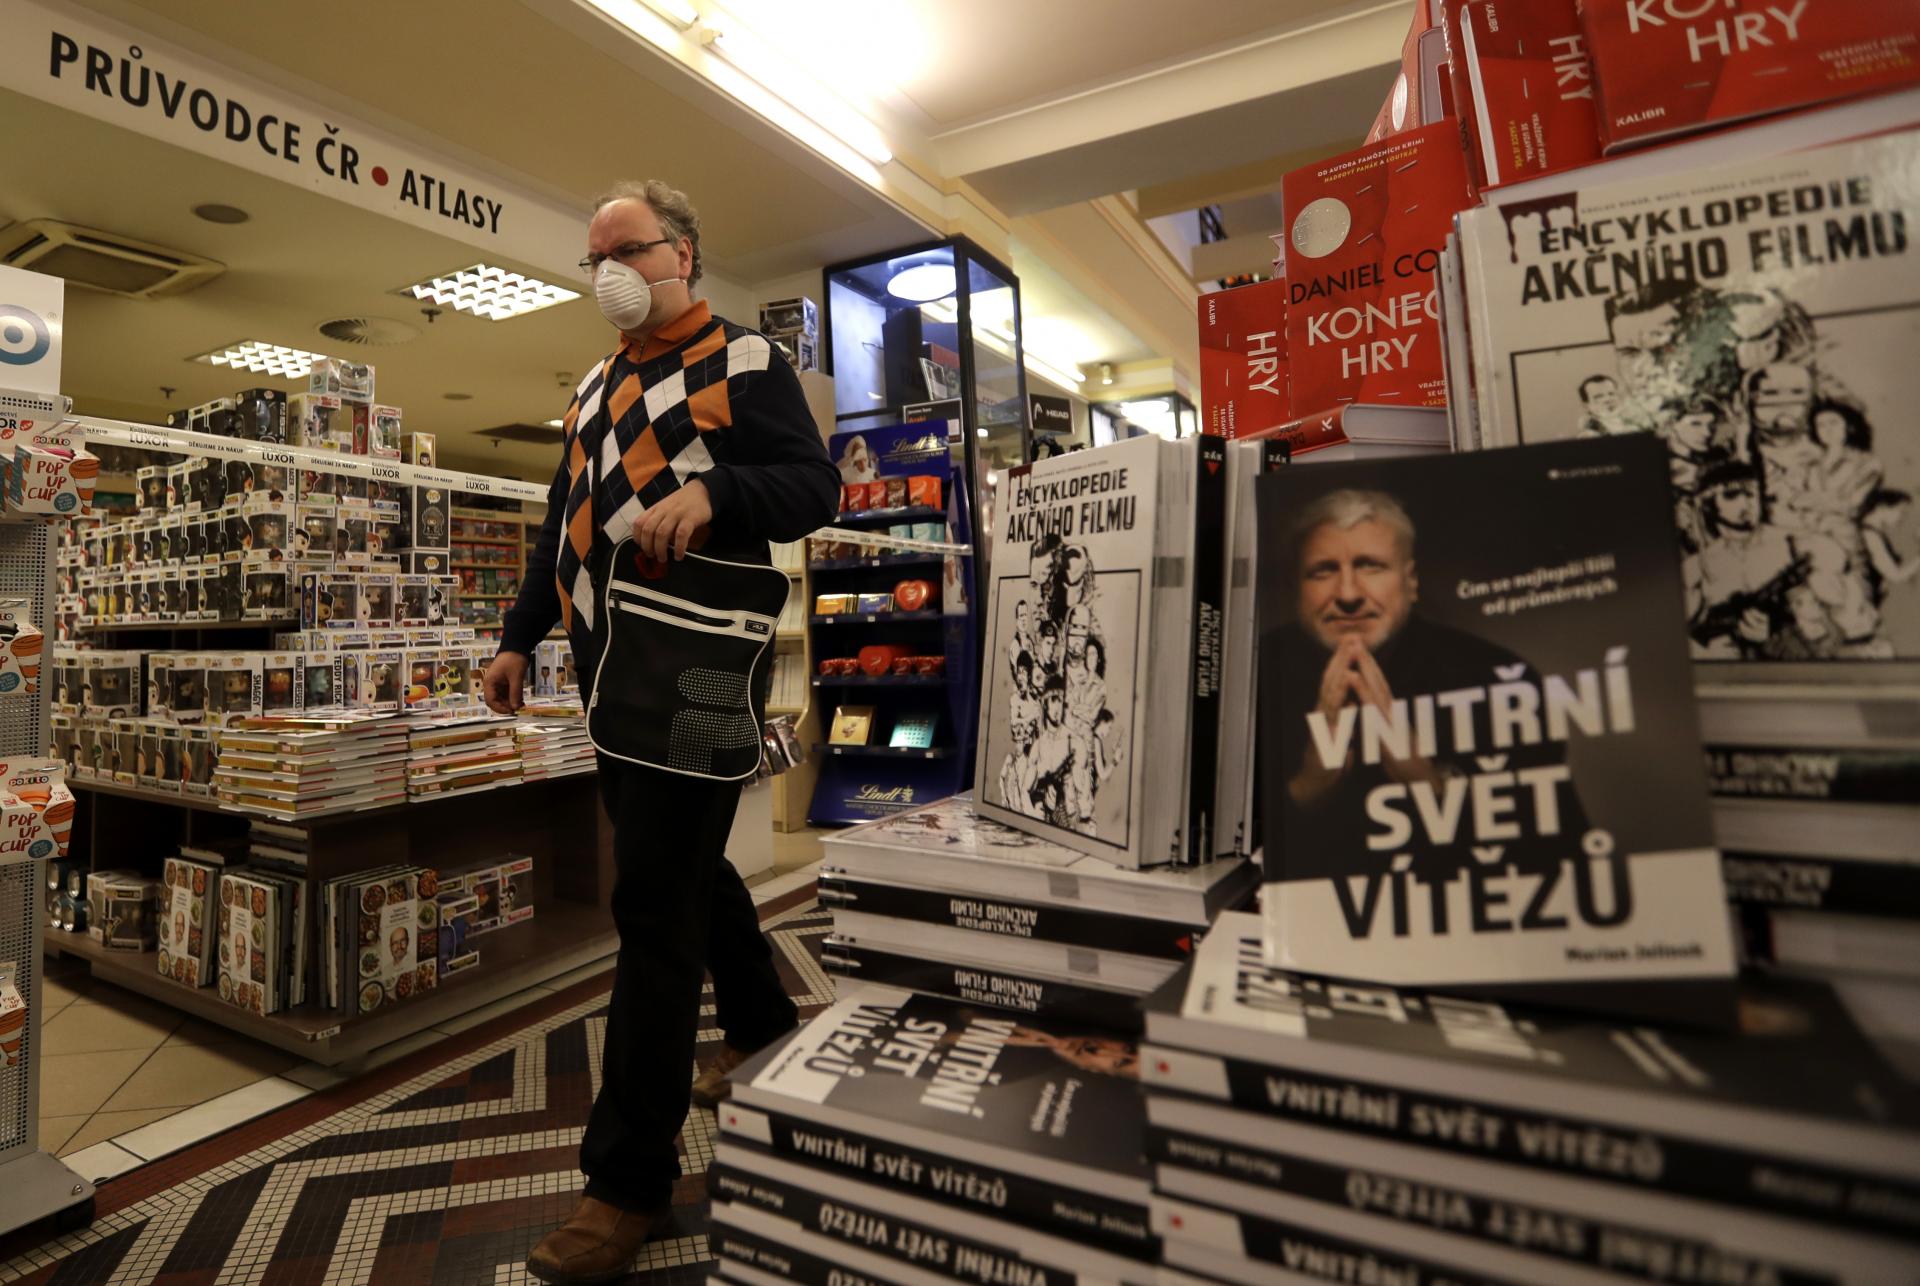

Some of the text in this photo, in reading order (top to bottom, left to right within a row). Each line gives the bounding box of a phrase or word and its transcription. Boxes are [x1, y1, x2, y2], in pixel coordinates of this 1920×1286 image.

[1484, 3, 1498, 33] KALIBR
[1687, 0, 1809, 63] HRY
[1549, 34, 1594, 100] HRY
[49, 31, 502, 234] PRŮVODCE ČR ATLASY
[1616, 107, 1665, 127] KALIBR
[1317, 138, 1425, 177] OD AUTORA FAMÓZNÍCH KRIMI
[1324, 170, 1354, 183] HADROVÝ
[1356, 162, 1378, 173] PANÁK
[1386, 148, 1418, 163] LOUTKÁŘ
[1539, 175, 1873, 254] ENCYKLOPEDIE
[1520, 210, 1908, 306] AKČNÍHO FILMU
[1291, 262, 1384, 305] DANIEL
[1247, 331, 1280, 395] HRY
[1342, 334, 1418, 379] HRY
[1418, 379, 1447, 389] VRAŽED
[129, 434, 169, 448] LUXOR
[188, 441, 218, 451] DĚKUJEME
[226, 446, 244, 454] NÁKUP
[262, 452, 295, 464] LUXOR
[36, 461, 64, 475] POP
[46, 476, 67, 489] UP
[310, 458, 334, 468] DĚKUJEME
[372, 467, 400, 479] LUXOR
[28, 487, 57, 501] CUP
[466, 481, 490, 492] LUXOR
[1016, 468, 1128, 508] ENCYKLOPEDIE
[1006, 495, 1136, 544] AKČNÍHO FILMU
[1457, 579, 1490, 599] Čím
[1491, 578, 1511, 592] se
[1512, 560, 1584, 588] nejlepší
[1482, 576, 1618, 616] od průměrných
[252, 674, 262, 707] SHAGGY
[334, 655, 342, 705] TEDDY RICK
[1306, 645, 1635, 770] VNITŘNÍ
[855, 784, 902, 801] Lindt
[1365, 754, 1571, 851] SVĚT
[8, 813, 38, 828] POP
[20, 826, 41, 838] UP
[0, 839, 31, 853] CUP
[1332, 829, 1634, 939] VÍTĚZŮ
[950, 900, 1038, 926] AKČNÍHO FILMU
[956, 916, 1032, 937] ENCYKLOPEDIE
[954, 970, 1043, 1000] AKČNÍHO FILMU
[960, 987, 1037, 1012] ENCYKLOPEDIE
[804, 1003, 900, 1078] VÍTĚZŮ
[872, 1017, 947, 1079] SVĚT
[920, 1017, 1018, 1118] VNITŘNÍ
[1265, 1074, 1665, 1181] VNITŘNÍ SVĚT VÍTĚZŮ
[792, 1130, 1008, 1208] VNITŘNÍ SVĚT VÍTĚZŮ
[1345, 1169, 1476, 1230] VÍTĚZŮ
[819, 1203, 1048, 1286] VNITŘNÍ SVĚT VÍTĚZŮ
[1487, 1201, 1584, 1254] SVĚT
